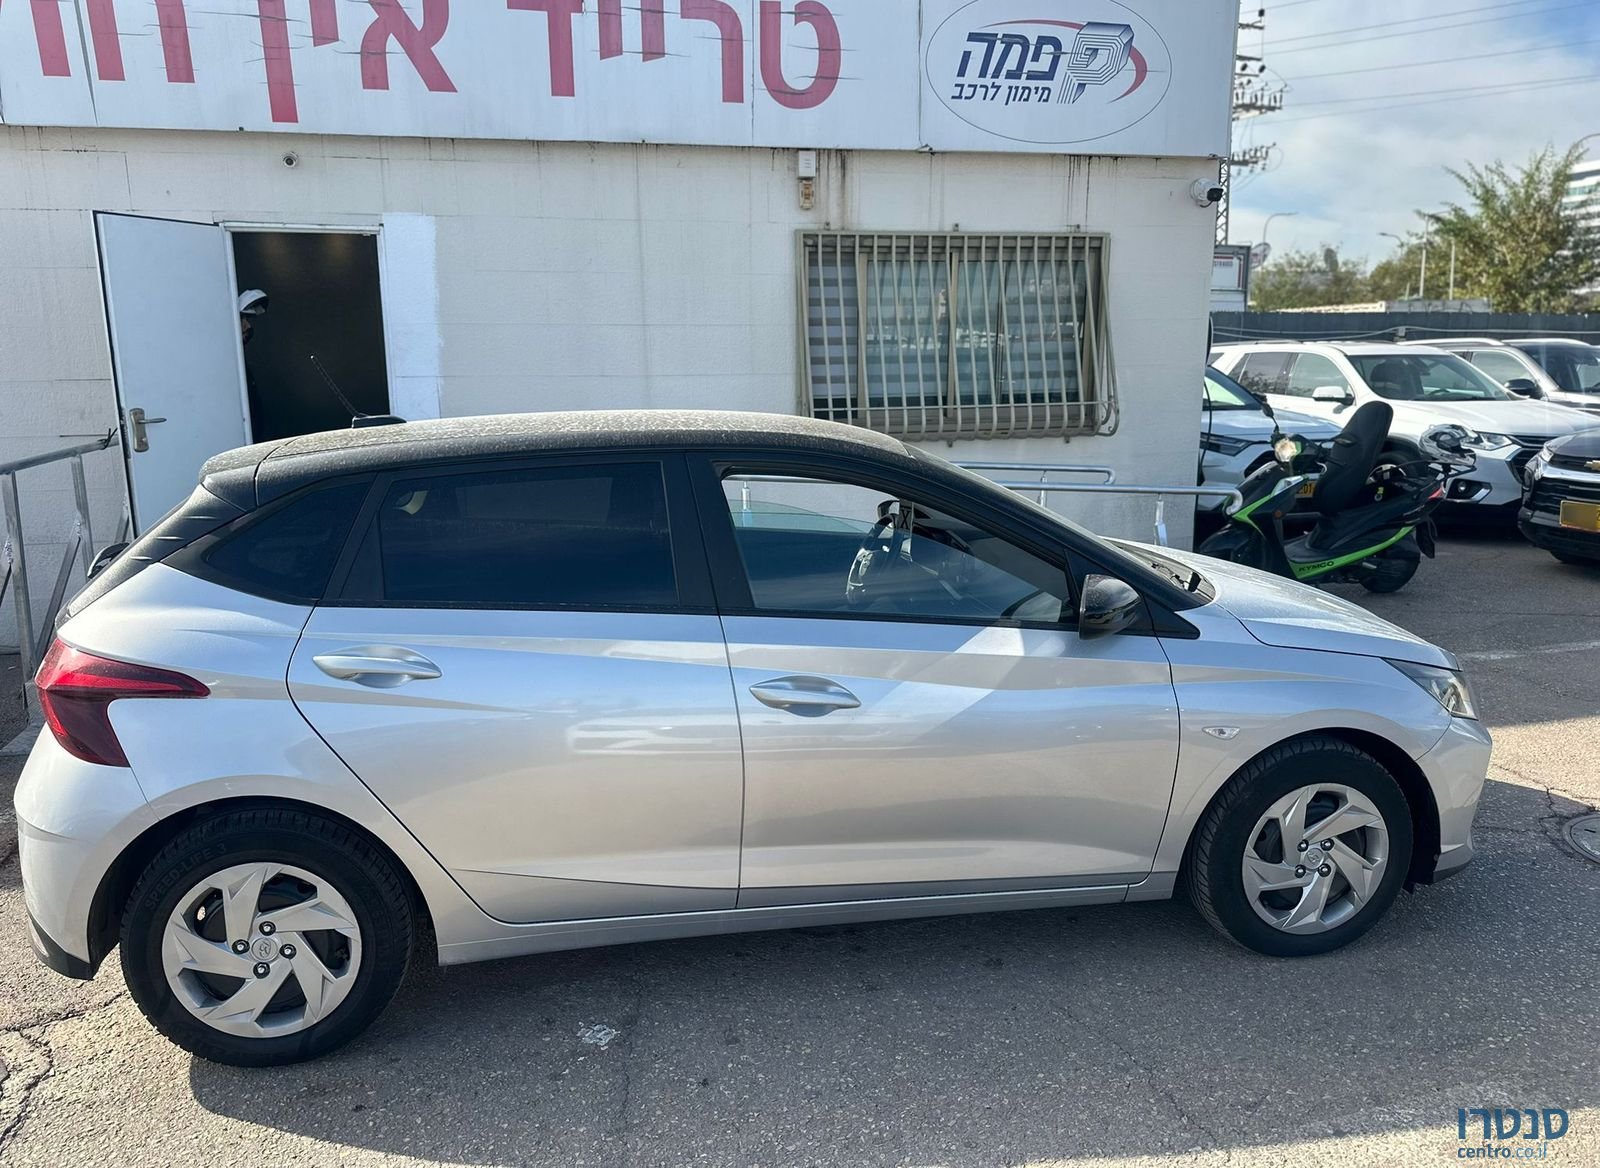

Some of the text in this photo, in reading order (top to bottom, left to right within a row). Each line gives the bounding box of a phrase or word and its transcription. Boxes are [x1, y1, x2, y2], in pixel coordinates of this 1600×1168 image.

[507, 0, 841, 109] טרייד
[956, 31, 1063, 81] פמה
[951, 81, 1052, 105] מימון לרכב
